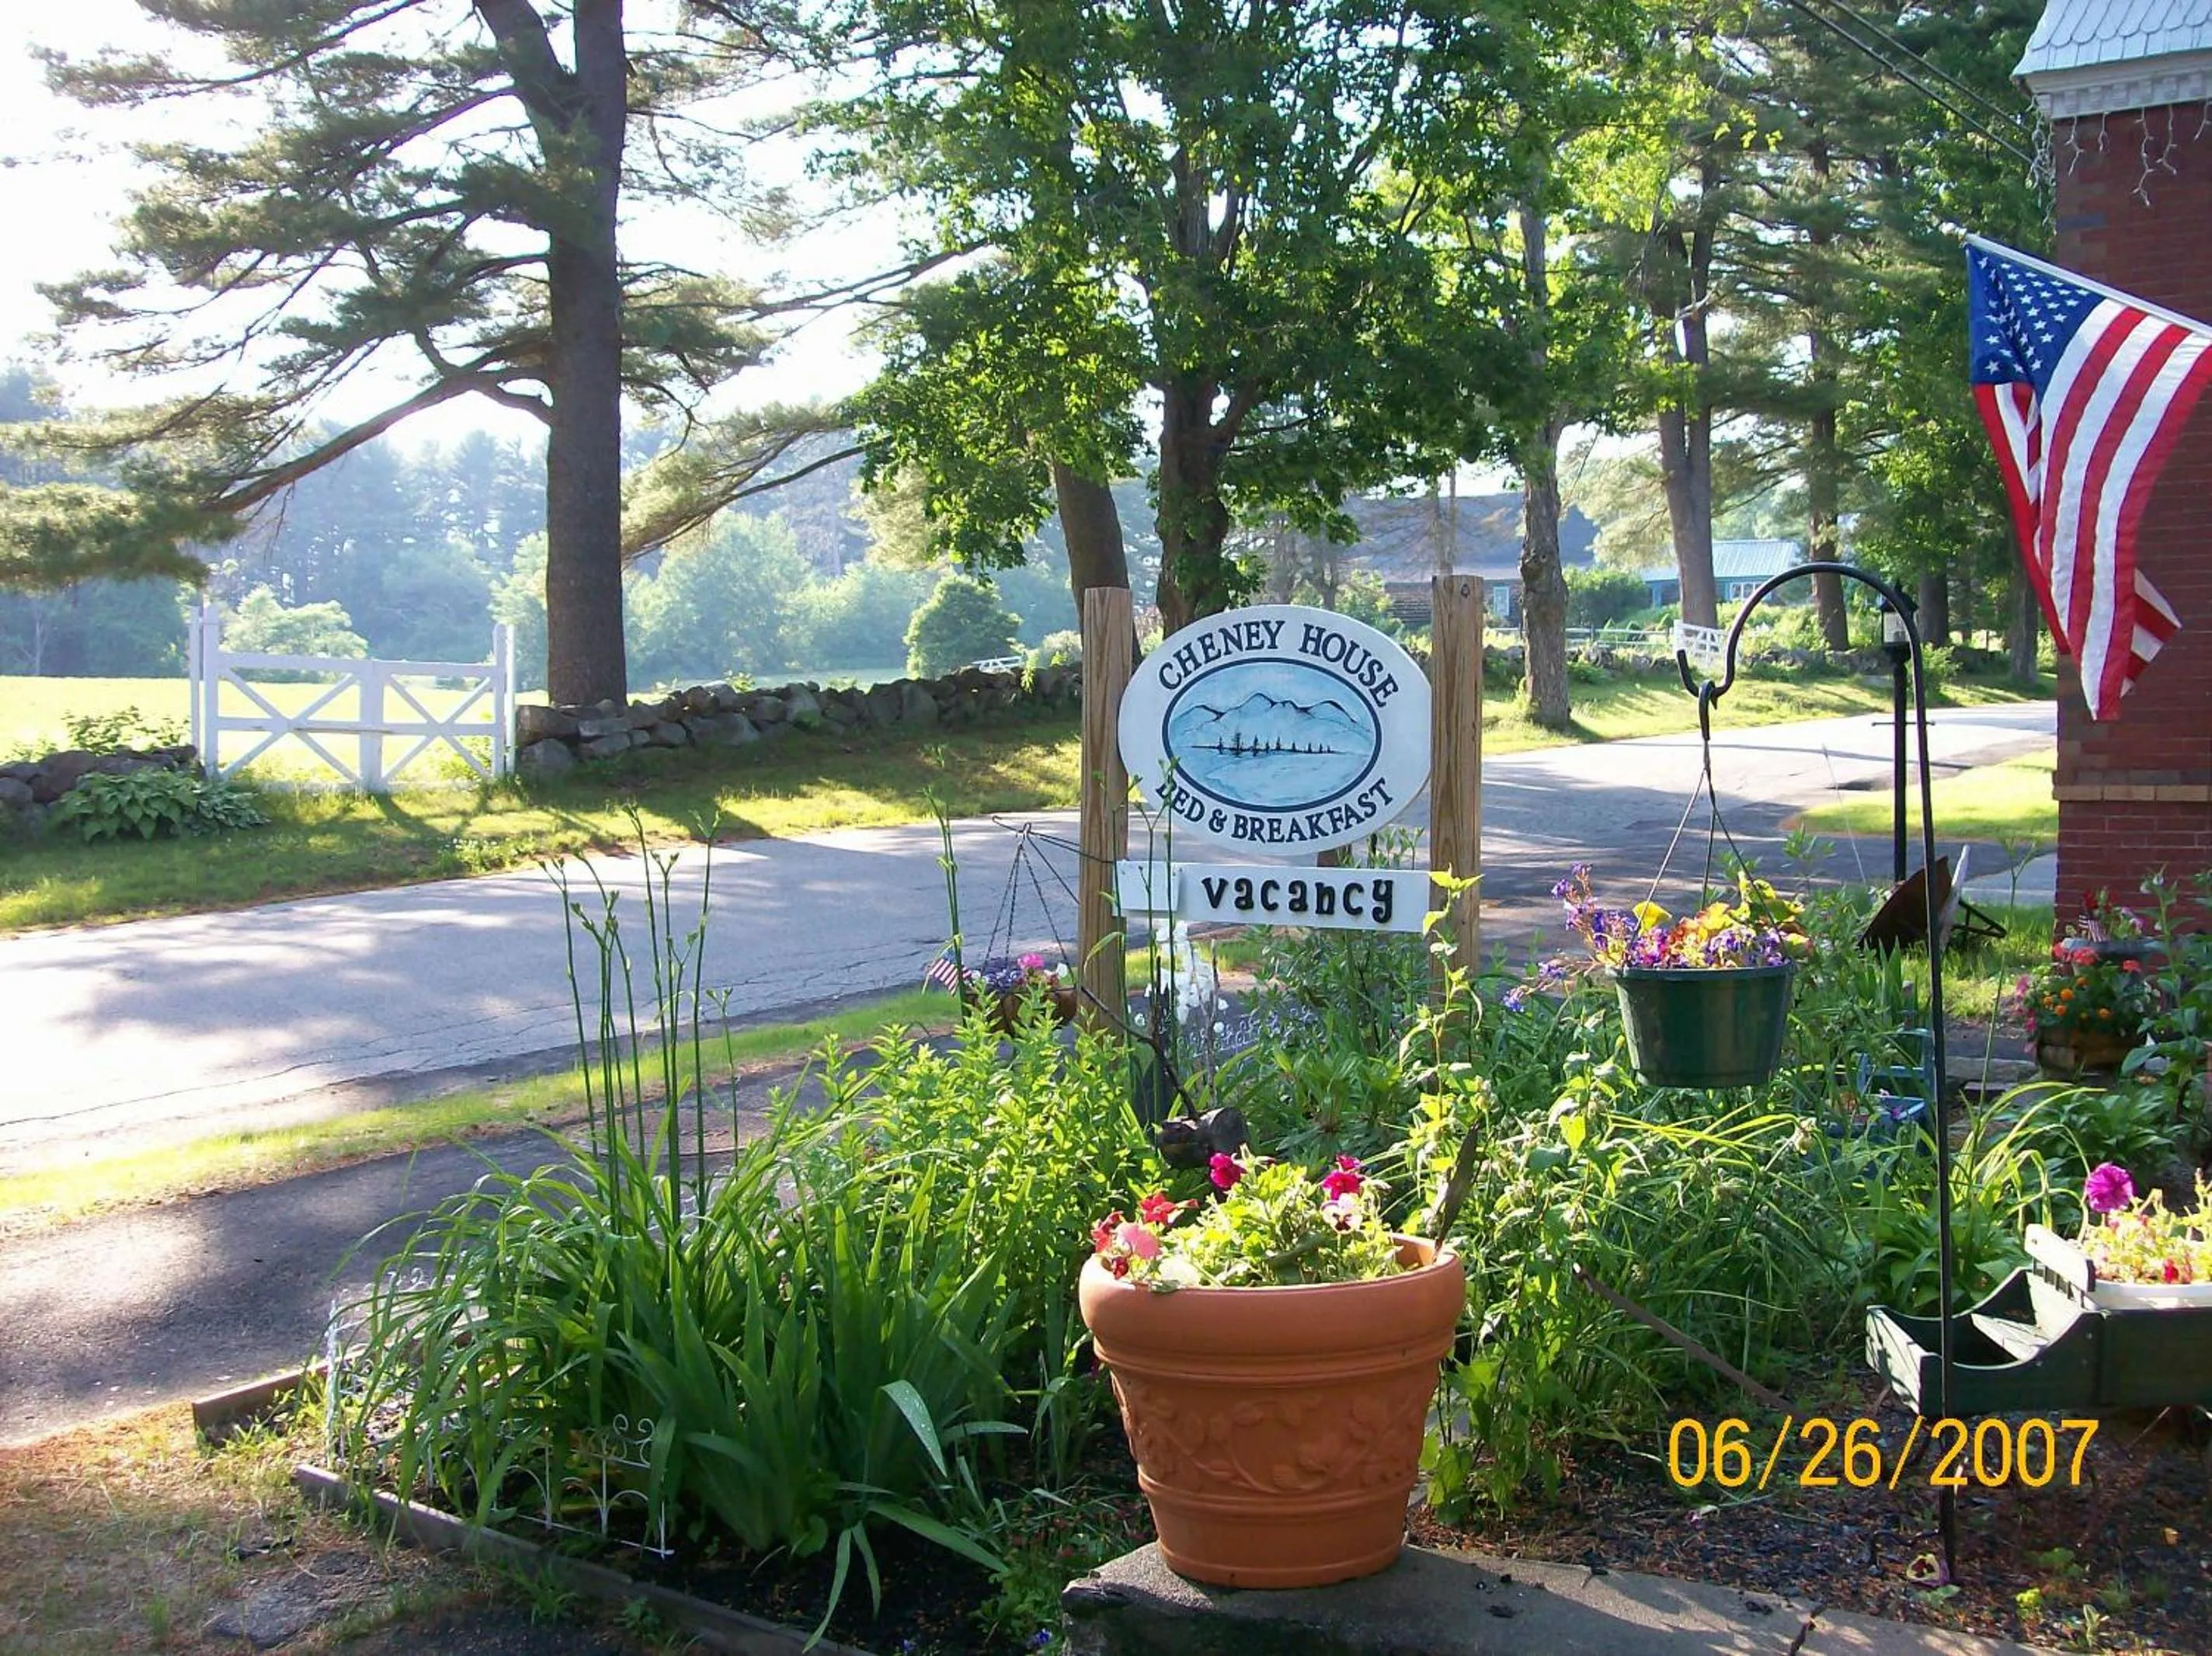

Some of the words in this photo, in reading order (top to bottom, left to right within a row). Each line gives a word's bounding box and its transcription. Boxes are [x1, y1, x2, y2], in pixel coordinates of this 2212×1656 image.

[1158, 620, 1285, 691] CHENEY
[1298, 623, 1400, 708] HOUSE
[1209, 808, 1228, 833] &
[1231, 778, 1396, 844] BREAKFAST
[1202, 876, 1394, 924] vacancy
